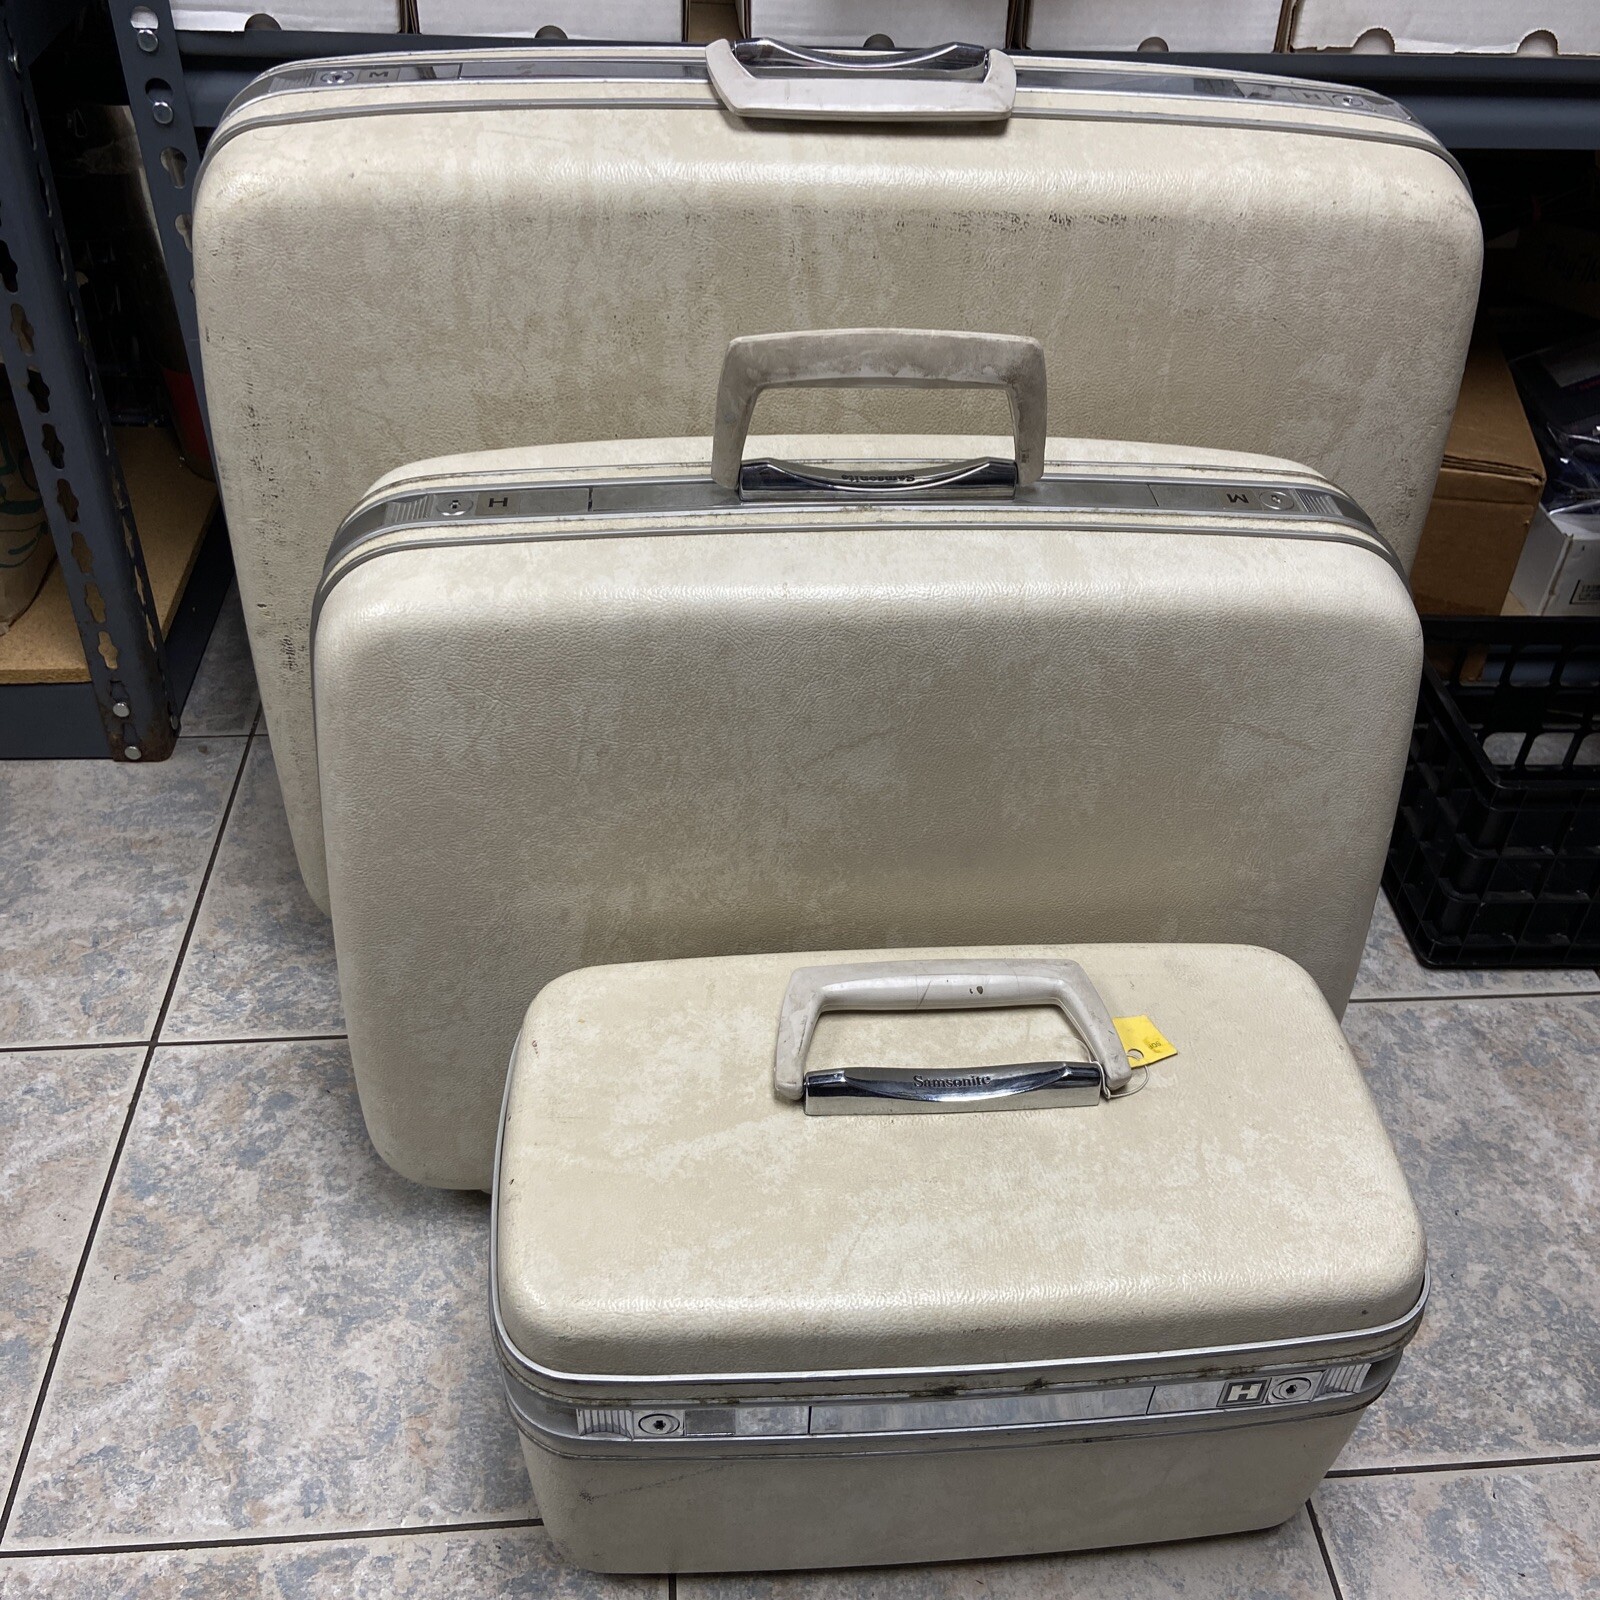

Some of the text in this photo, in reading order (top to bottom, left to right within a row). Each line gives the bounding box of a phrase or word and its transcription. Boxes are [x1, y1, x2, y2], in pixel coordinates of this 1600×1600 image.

[489, 497, 508, 507] H
[913, 1075, 991, 1088] Samsonite
[1227, 1383, 1263, 1401] H
